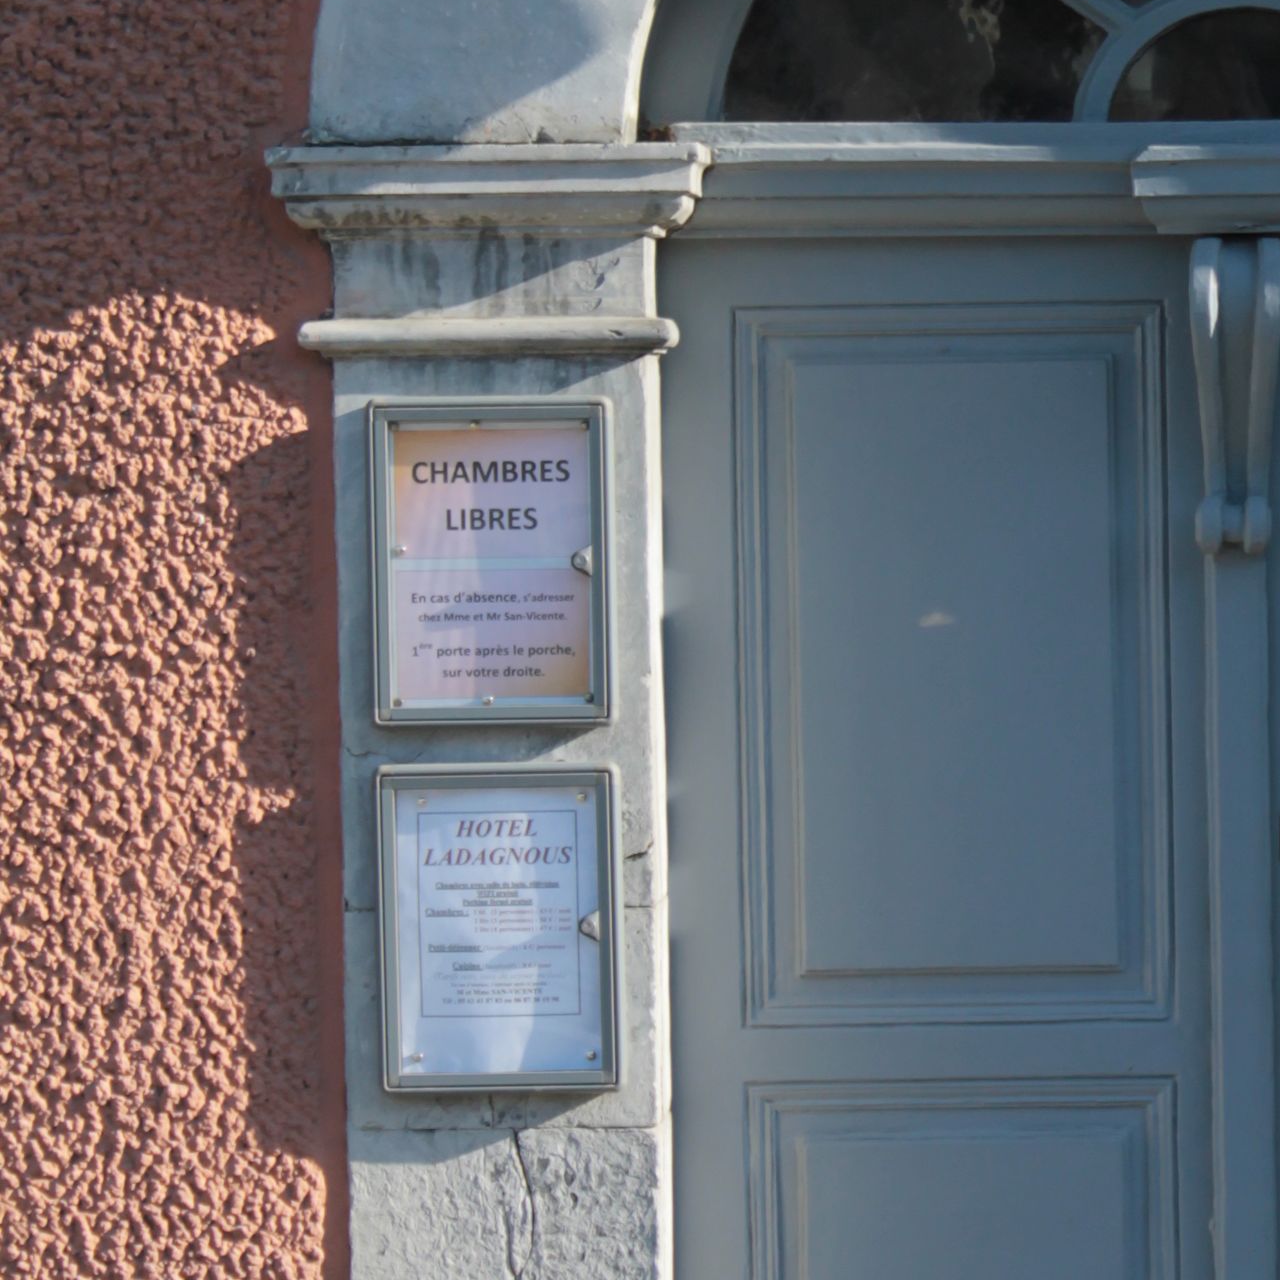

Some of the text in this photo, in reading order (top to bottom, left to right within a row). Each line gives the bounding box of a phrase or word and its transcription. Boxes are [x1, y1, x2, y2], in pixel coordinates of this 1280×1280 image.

[411, 459, 571, 484] CHAMBRES
[445, 507, 539, 531] LIBRES
[411, 593, 426, 604] En
[430, 595, 450, 604] cas
[523, 592, 575, 602] s'adresser
[418, 613, 441, 622] chez
[444, 613, 470, 622] Mme
[473, 613, 483, 621] et
[486, 612, 501, 621] Mr
[436, 646, 471, 659] porte
[475, 645, 510, 658] après
[513, 644, 524, 656] le
[528, 644, 576, 658] porche,
[442, 666, 545, 678] sur votre droite.
[456, 818, 538, 838] HOTEL
[423, 846, 573, 867] LADAGNOUS
